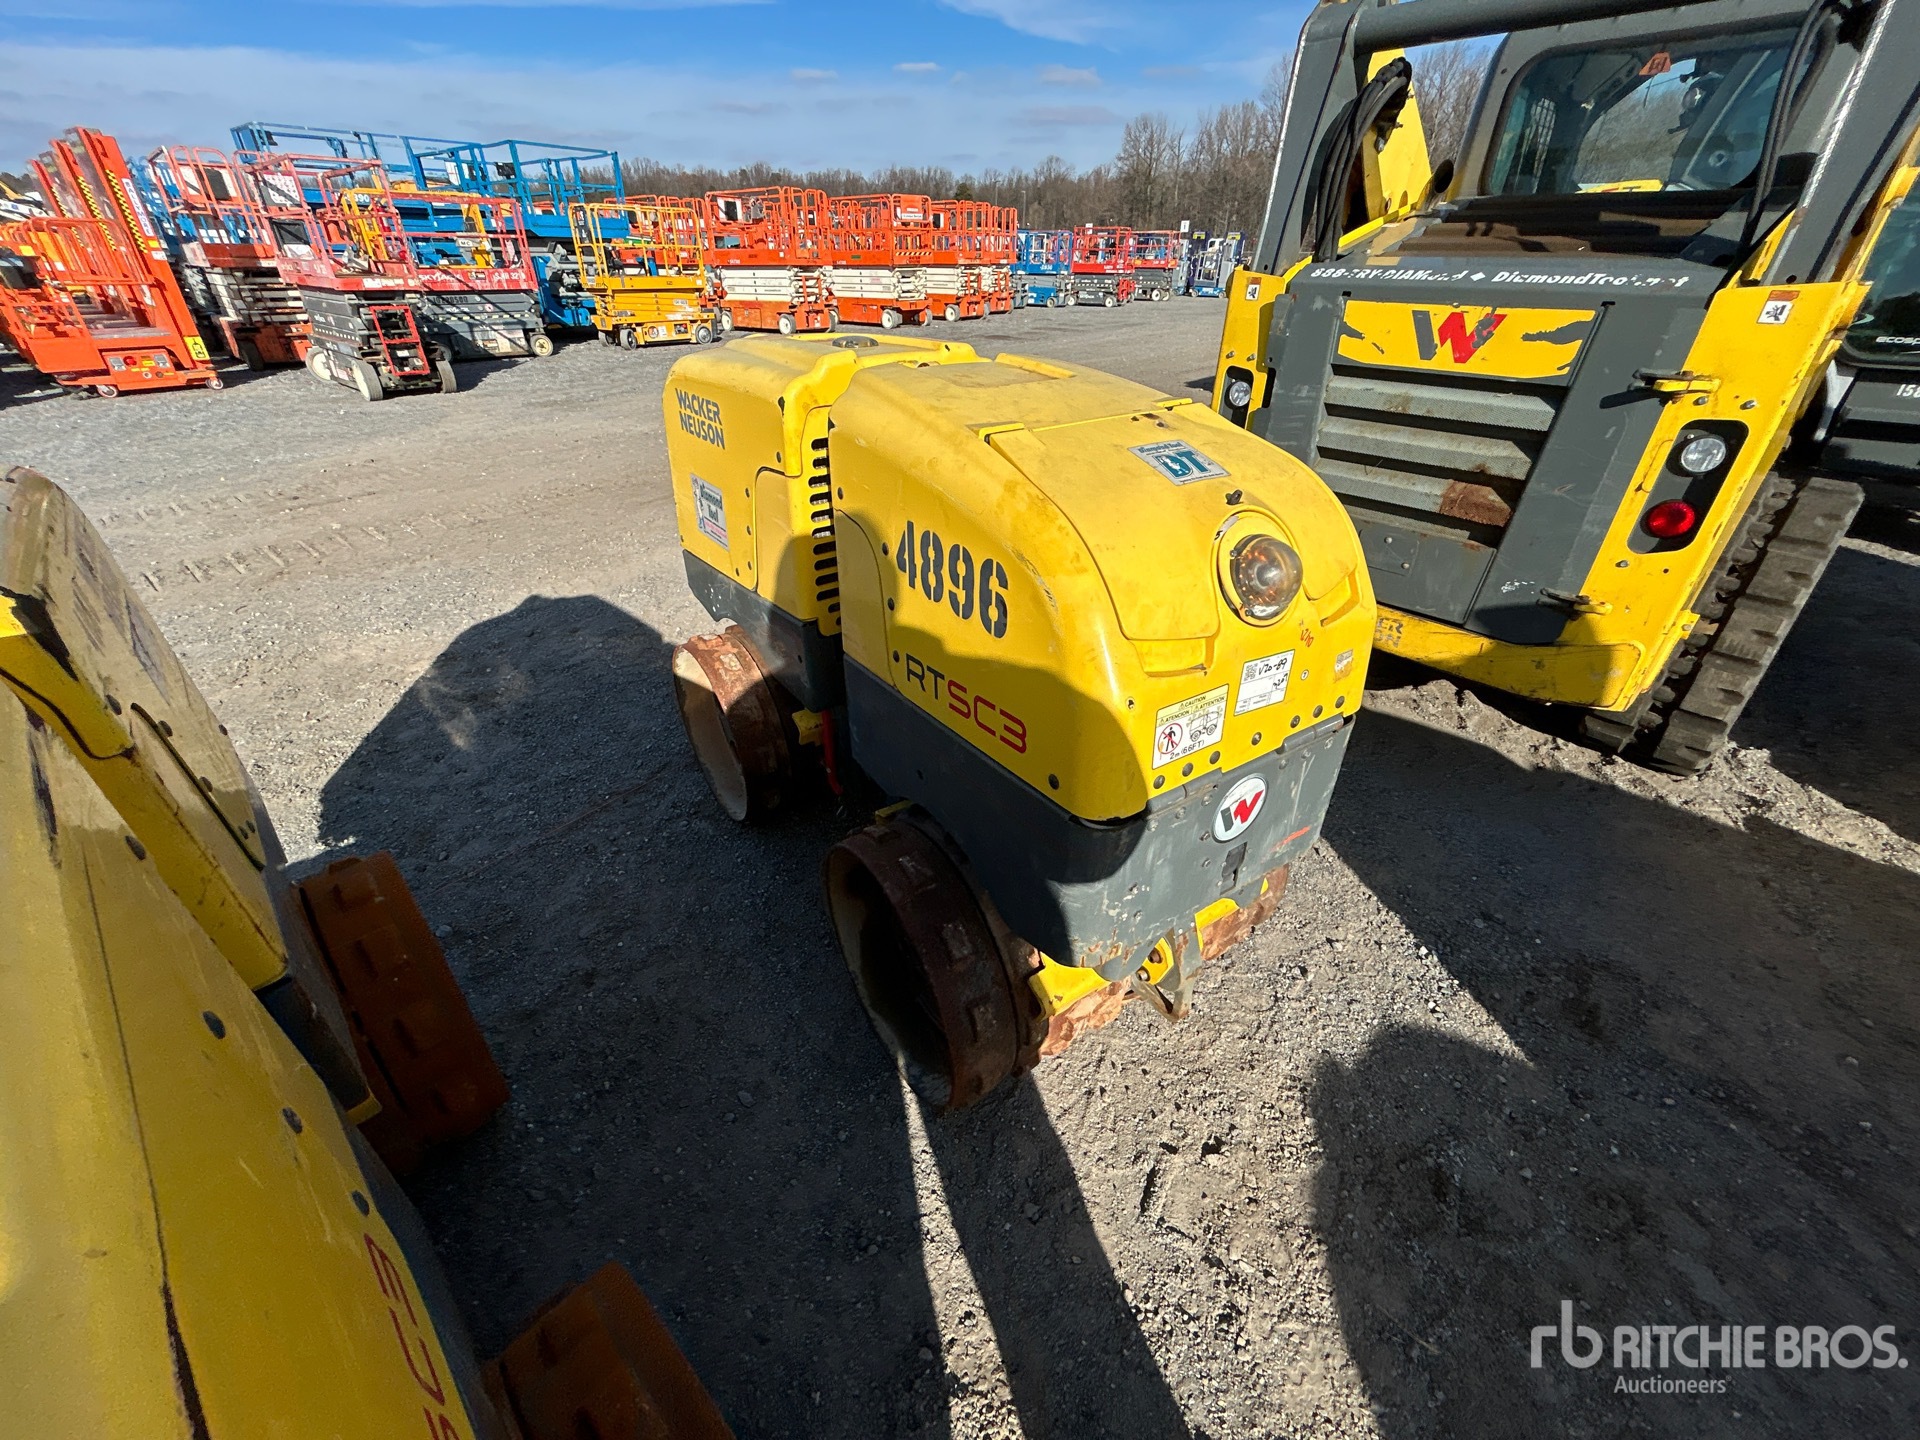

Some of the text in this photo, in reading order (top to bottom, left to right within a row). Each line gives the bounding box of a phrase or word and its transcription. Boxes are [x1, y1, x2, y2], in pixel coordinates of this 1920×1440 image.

[124, 180, 152, 236] BALLYMORE
[675, 387, 723, 426] WACKER
[679, 410, 726, 450] NEUSON
[707, 503, 719, 523] Tool
[895, 519, 1009, 639] 4896
[905, 652, 1028, 755] RTSC3
[1184, 695, 1207, 708] CAUTION
[1199, 696, 1225, 710] ATTENTION
